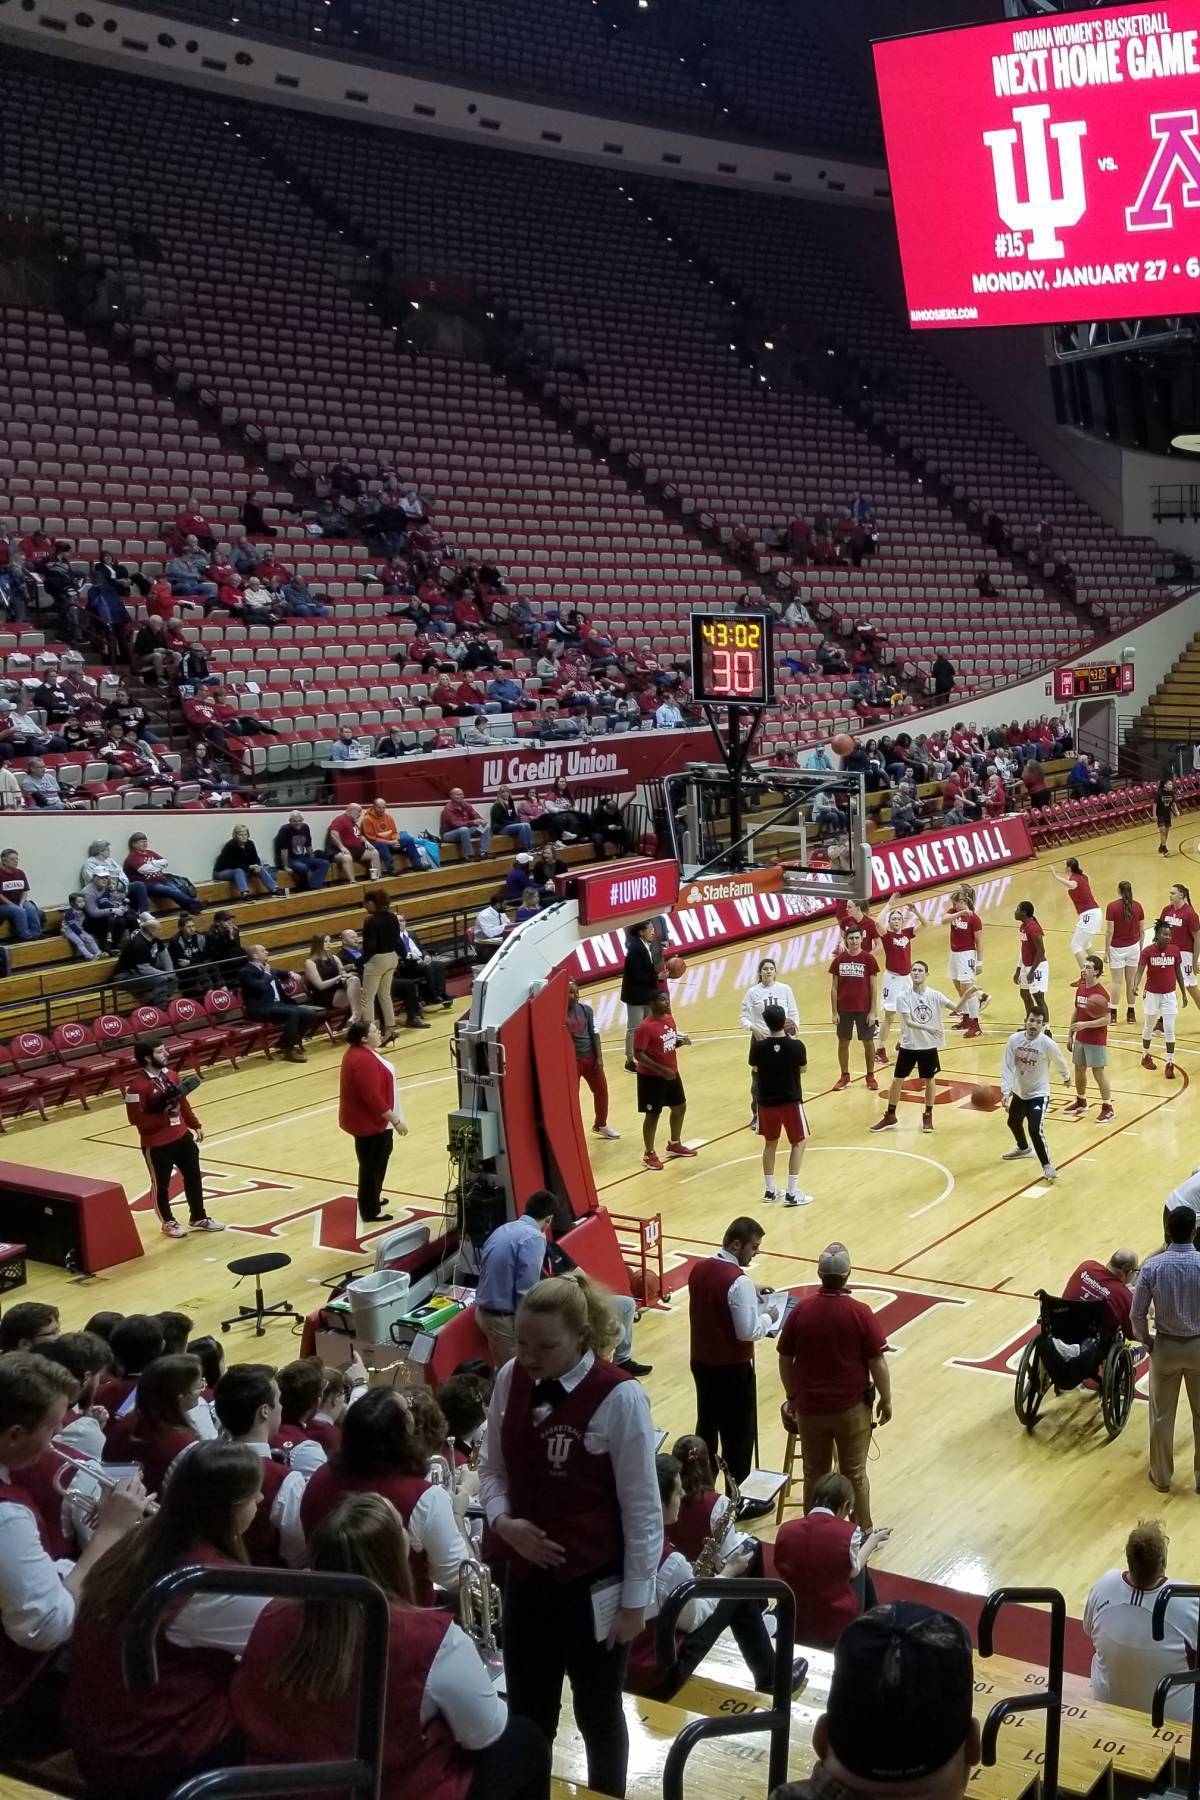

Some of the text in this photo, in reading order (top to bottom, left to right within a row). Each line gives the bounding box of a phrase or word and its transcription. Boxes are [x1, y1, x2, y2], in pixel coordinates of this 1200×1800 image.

[1013, 12, 1171, 51] INDIANA WOMEN'S BASKETBALL
[992, 30, 1200, 97] NEXT HOME GAME
[995, 233, 1024, 258] #15
[972, 270, 1050, 294] MONDAY,
[1053, 262, 1140, 290] JANUARY
[1144, 259, 1168, 281] 27
[911, 307, 978, 322] IUHOOSIERS.COM
[702, 623, 760, 649] 43:02
[713, 650, 754, 692] 30
[483, 748, 617, 785] IU Credit Union
[871, 826, 1012, 892] BASKETBALL
[610, 875, 657, 906] #IUWBB
[839, 962, 865, 972] INDIANA
[1150, 956, 1175, 966] INDIANA
[1084, 1275, 1111, 1297] Smithville
[1092, 1738, 1126, 1756] 101
[1152, 1728, 1184, 1744] 101
